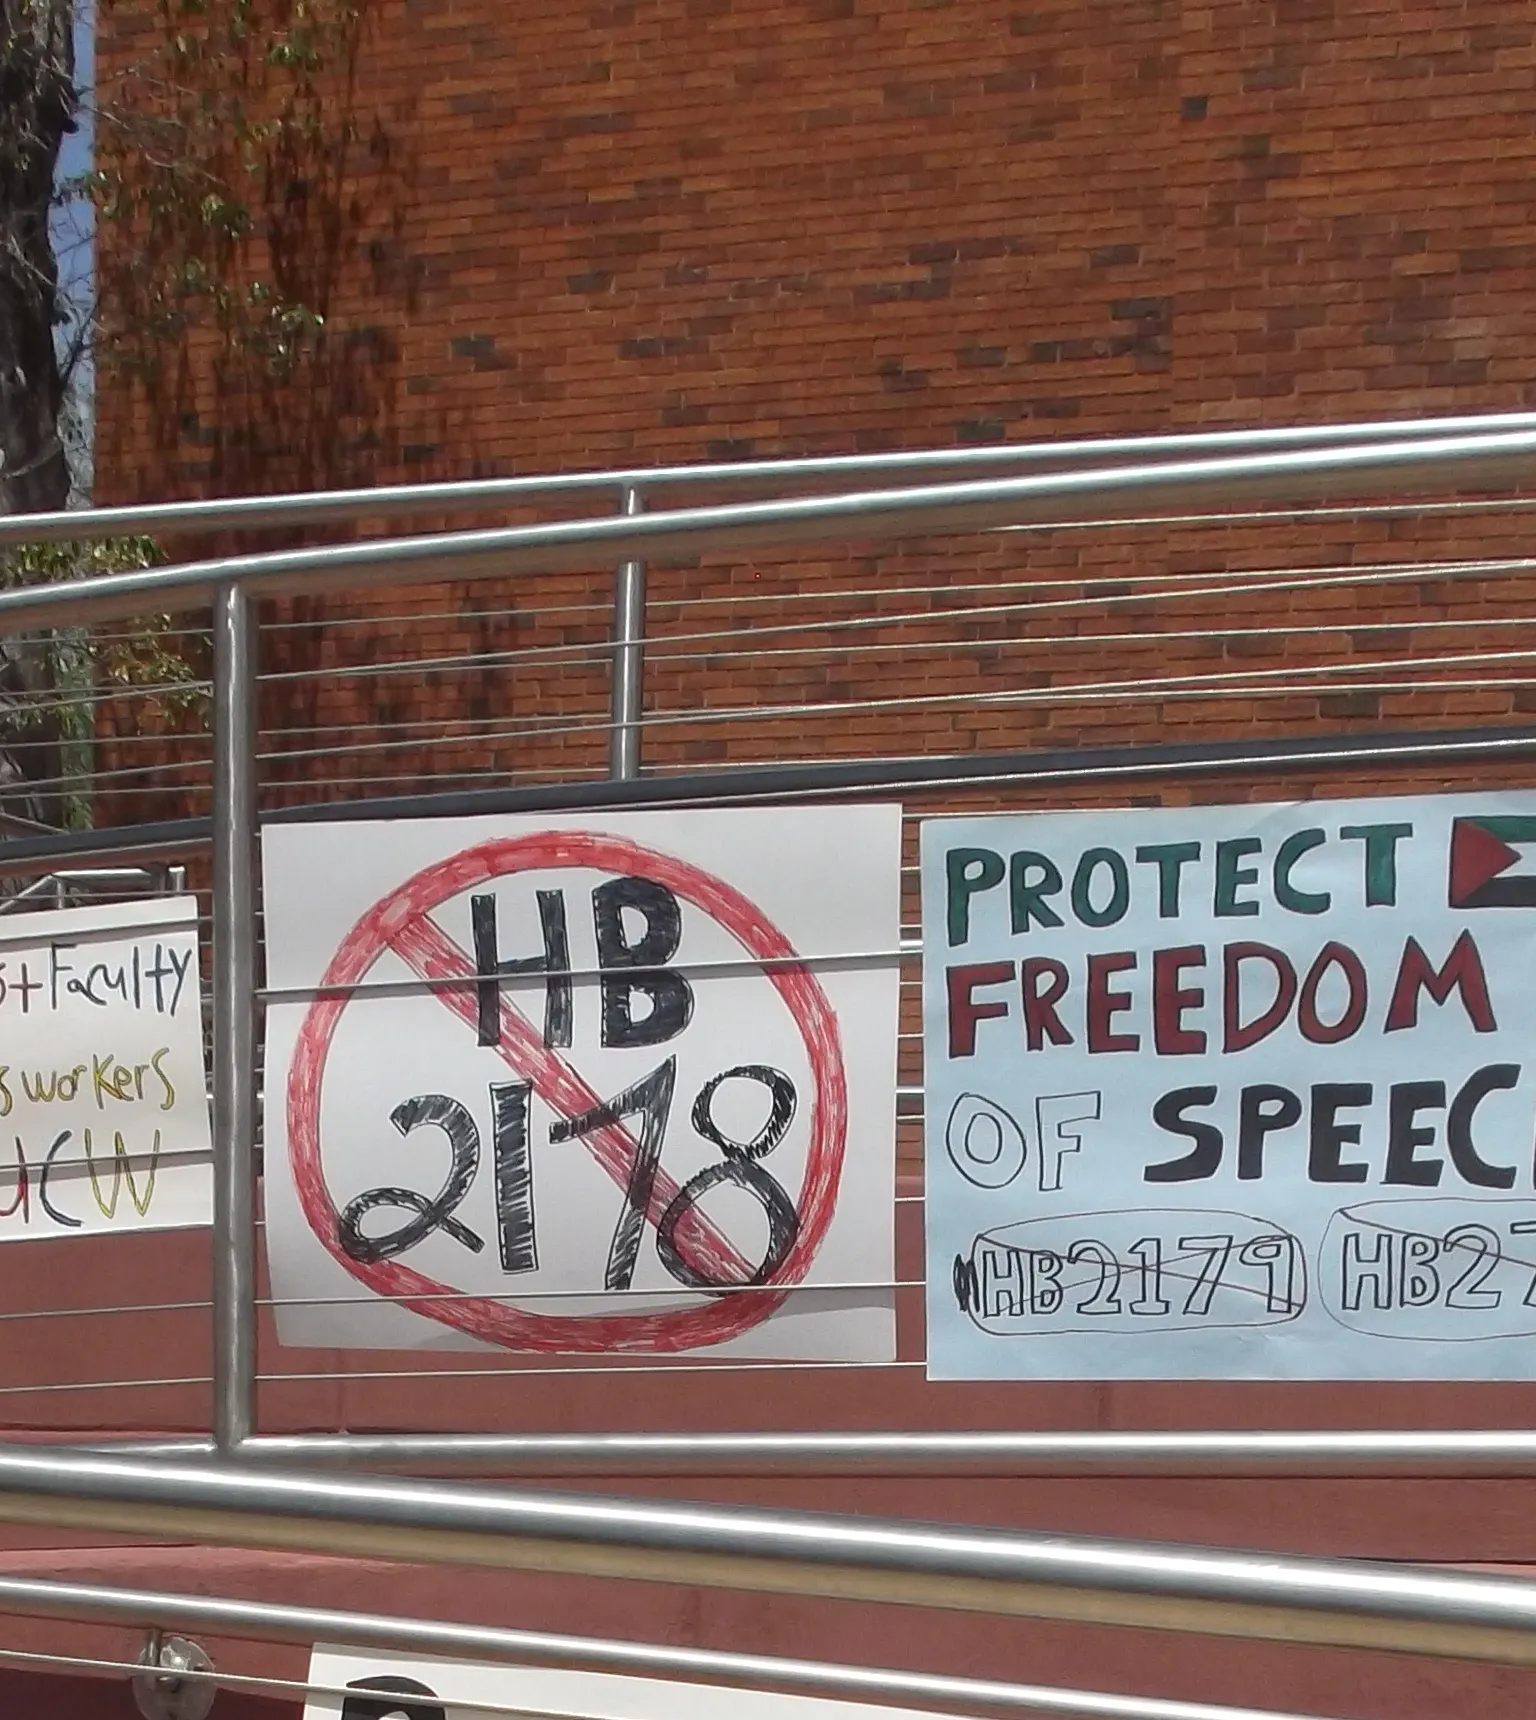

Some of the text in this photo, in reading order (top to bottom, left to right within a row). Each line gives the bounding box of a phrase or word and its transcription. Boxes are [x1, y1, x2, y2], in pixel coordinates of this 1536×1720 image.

[945, 822, 1413, 948] PROTECT
[471, 875, 696, 1048] HB
[945, 928, 1498, 1059] FREEDOM
[338, 1053, 802, 1297] 2178
[945, 1089, 1102, 1192] OF
